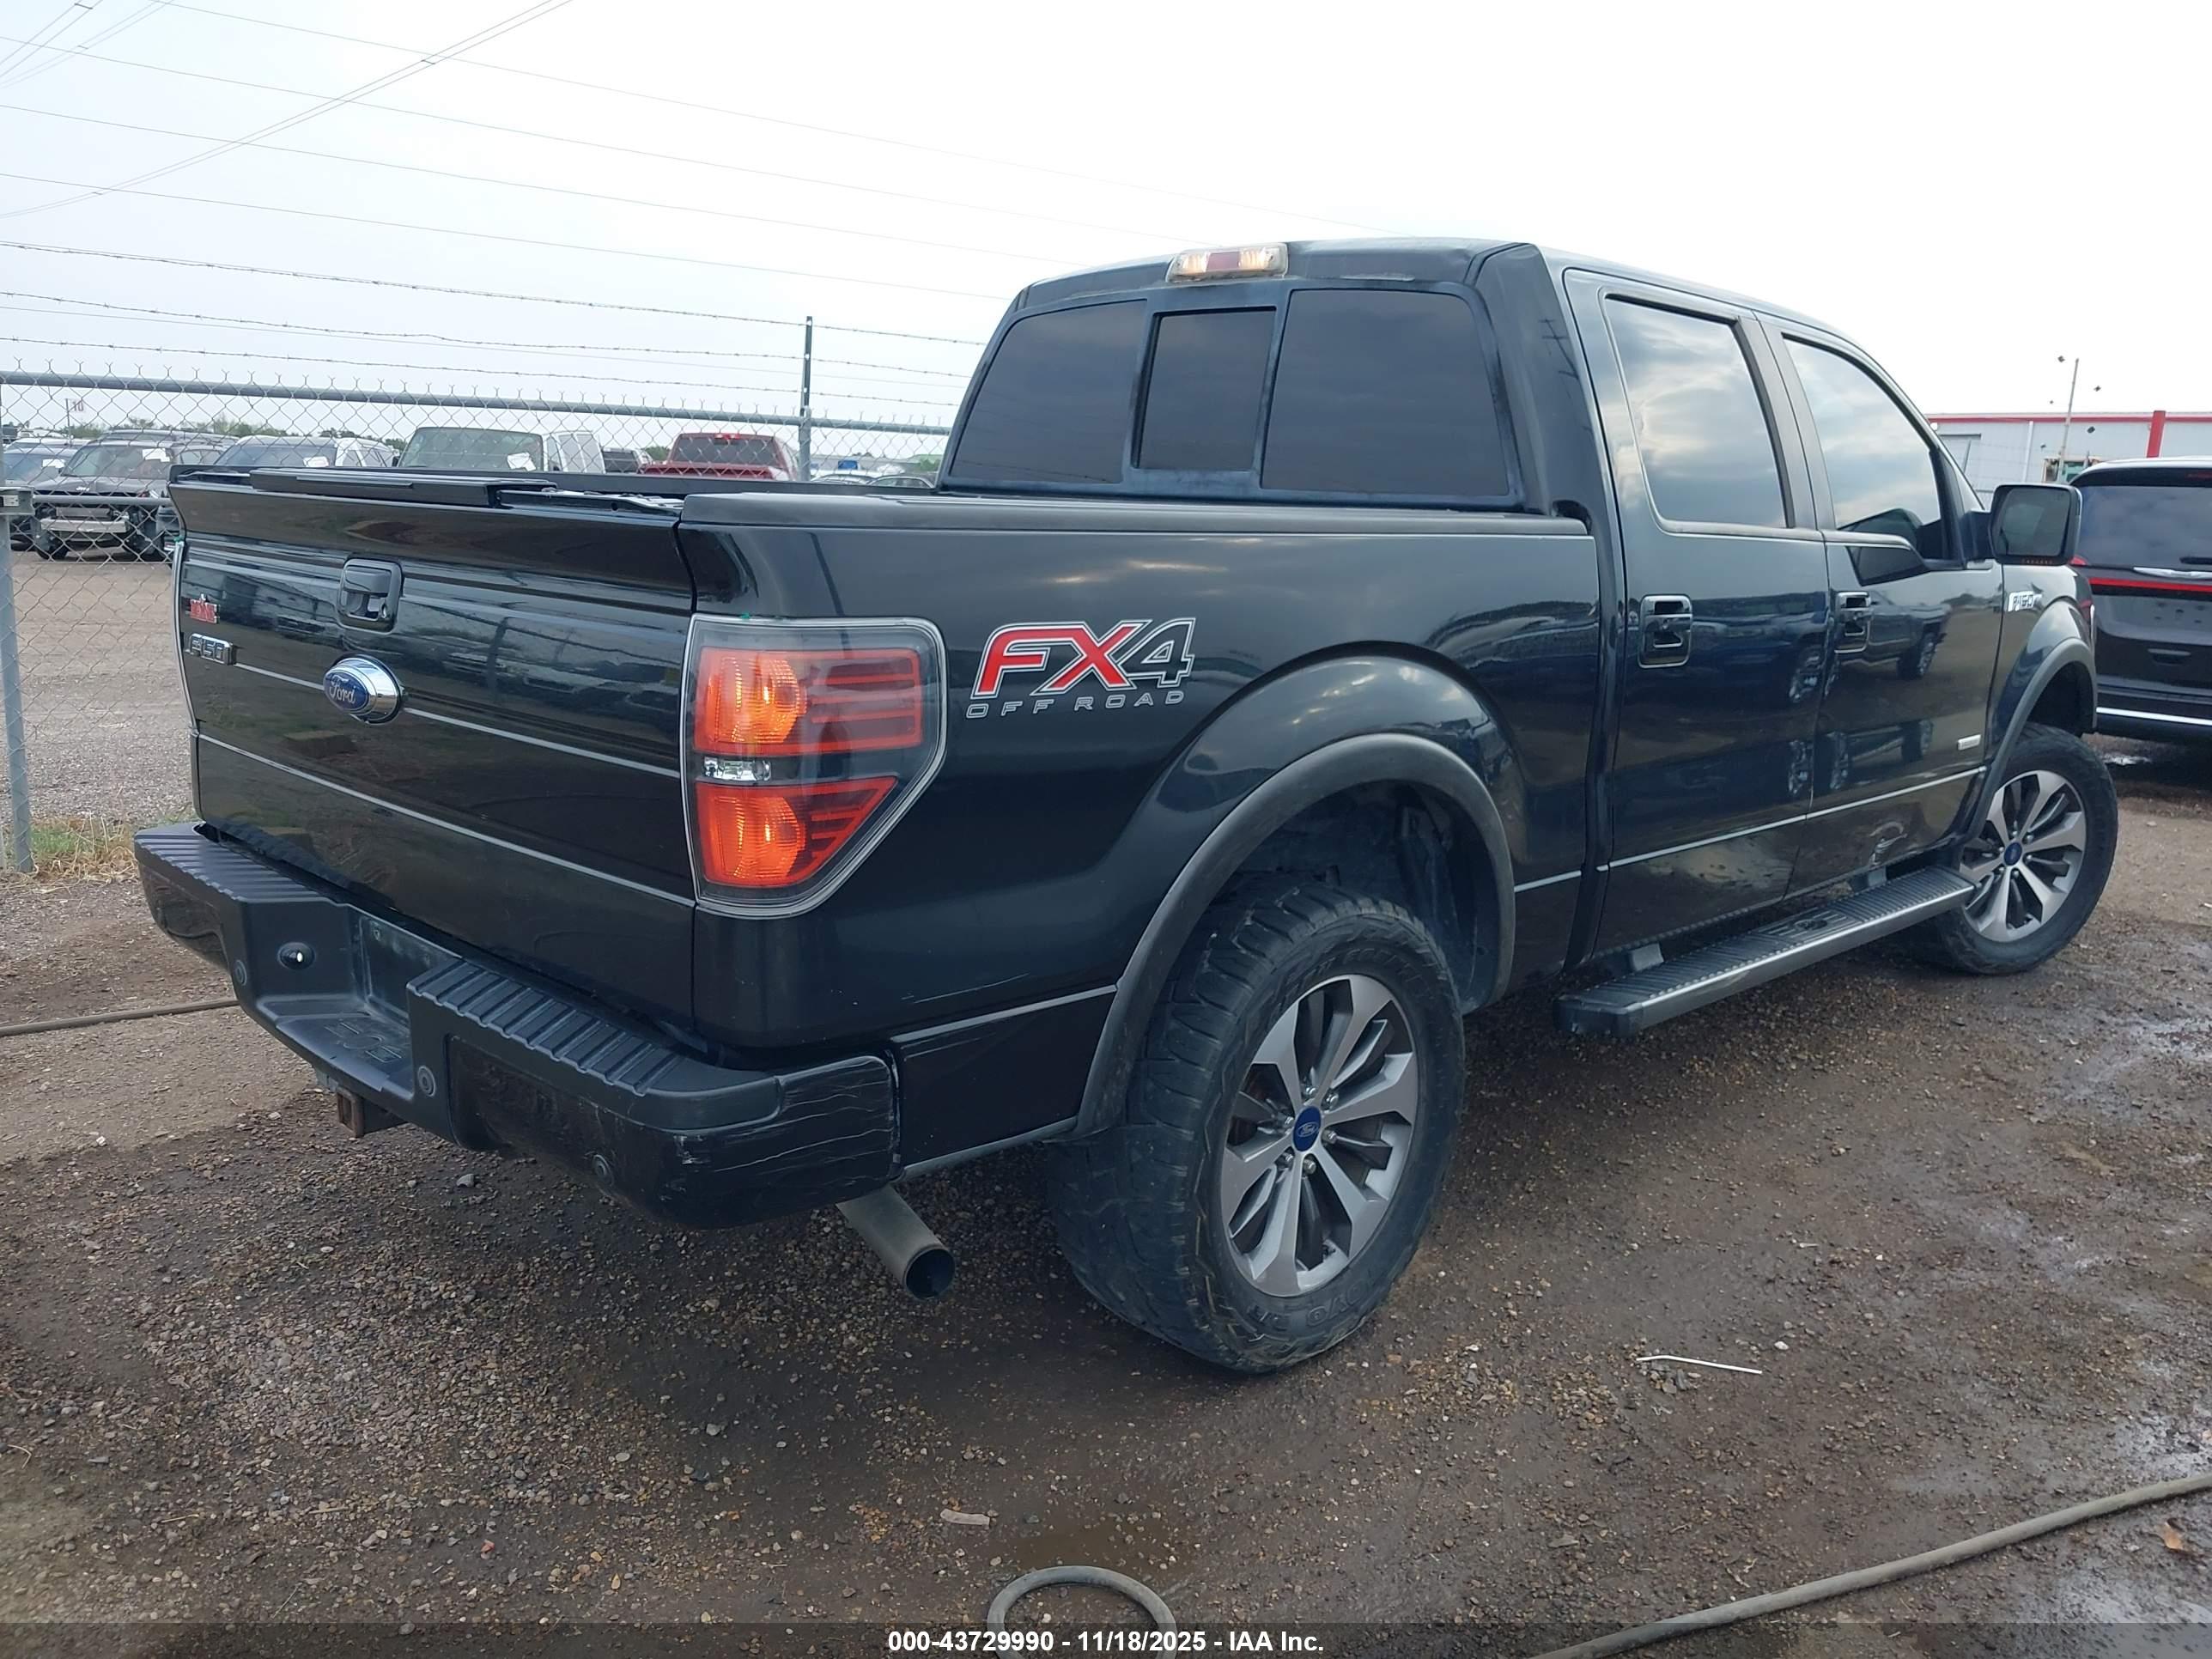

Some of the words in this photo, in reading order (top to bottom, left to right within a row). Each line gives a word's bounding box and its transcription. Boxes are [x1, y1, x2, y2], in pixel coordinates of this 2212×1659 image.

[970, 617, 1196, 699] FX4
[329, 674, 357, 705] Ford
[1073, 690, 1185, 711] ROAD
